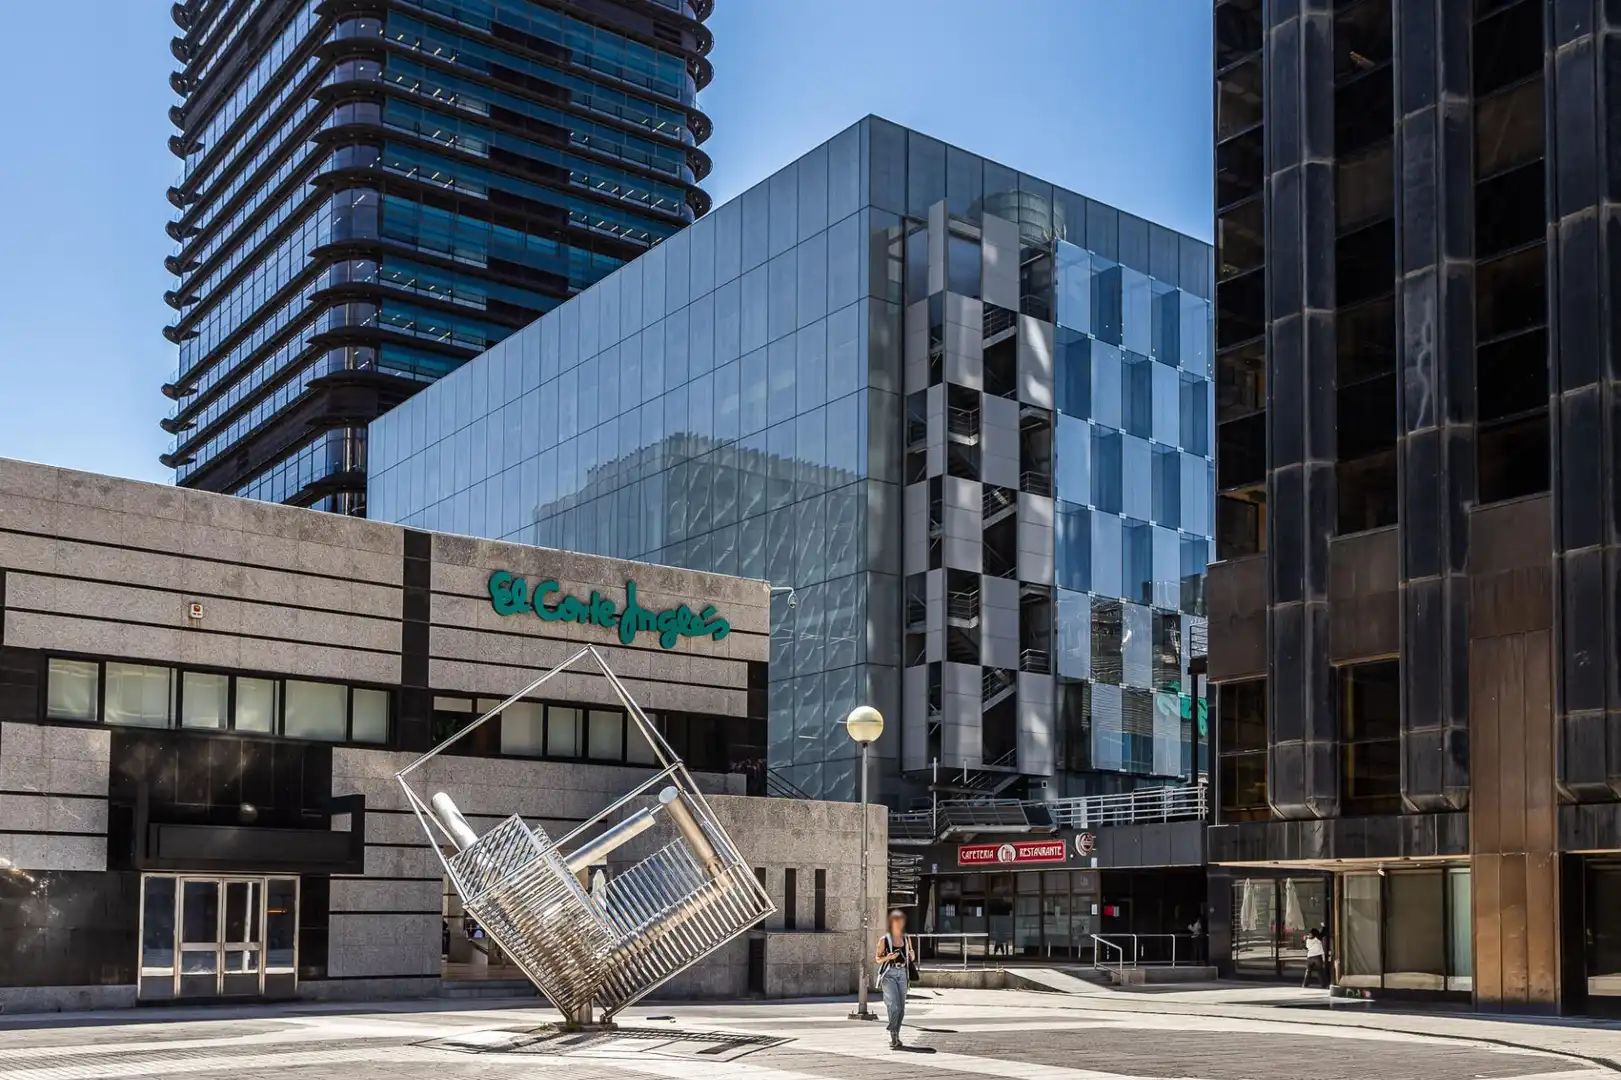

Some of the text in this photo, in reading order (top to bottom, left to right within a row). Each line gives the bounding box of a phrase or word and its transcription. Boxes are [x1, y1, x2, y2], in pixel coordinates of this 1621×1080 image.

[488, 570, 730, 649] El Corte Inglés
[961, 850, 994, 860] CAFETERIA
[1019, 846, 1062, 858] RESTAURANTE
